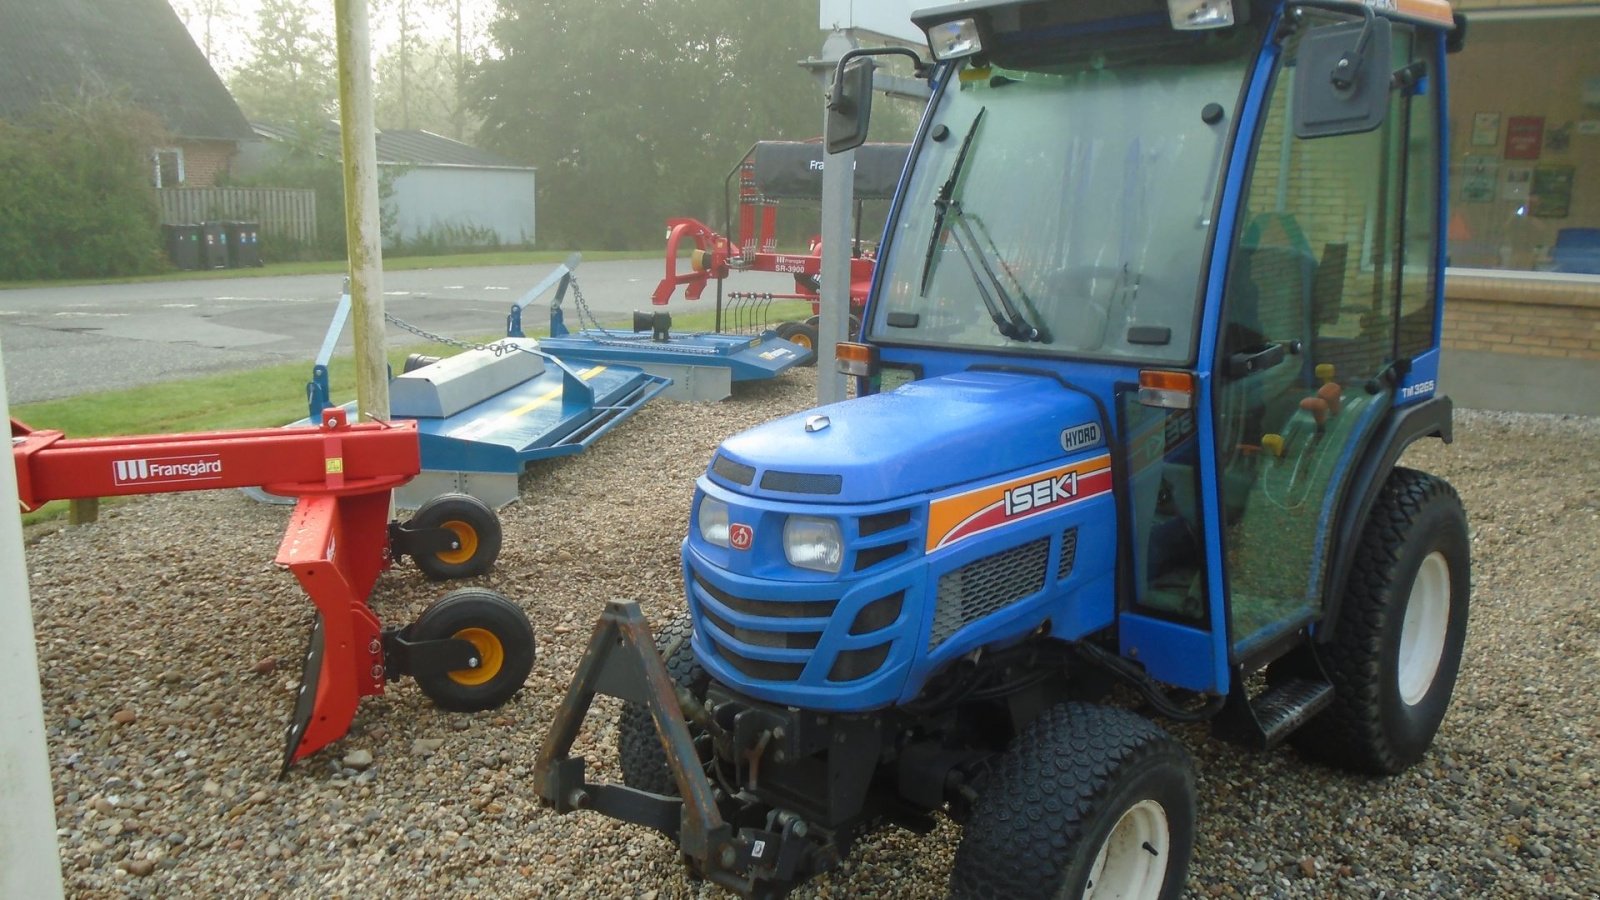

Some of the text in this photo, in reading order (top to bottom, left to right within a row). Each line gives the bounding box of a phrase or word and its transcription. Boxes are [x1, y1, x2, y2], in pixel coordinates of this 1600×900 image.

[775, 264, 805, 273] SR-3900
[1065, 425, 1096, 448] HYDRO
[149, 459, 222, 477] Fransgård
[1004, 471, 1078, 517] ISEKI
